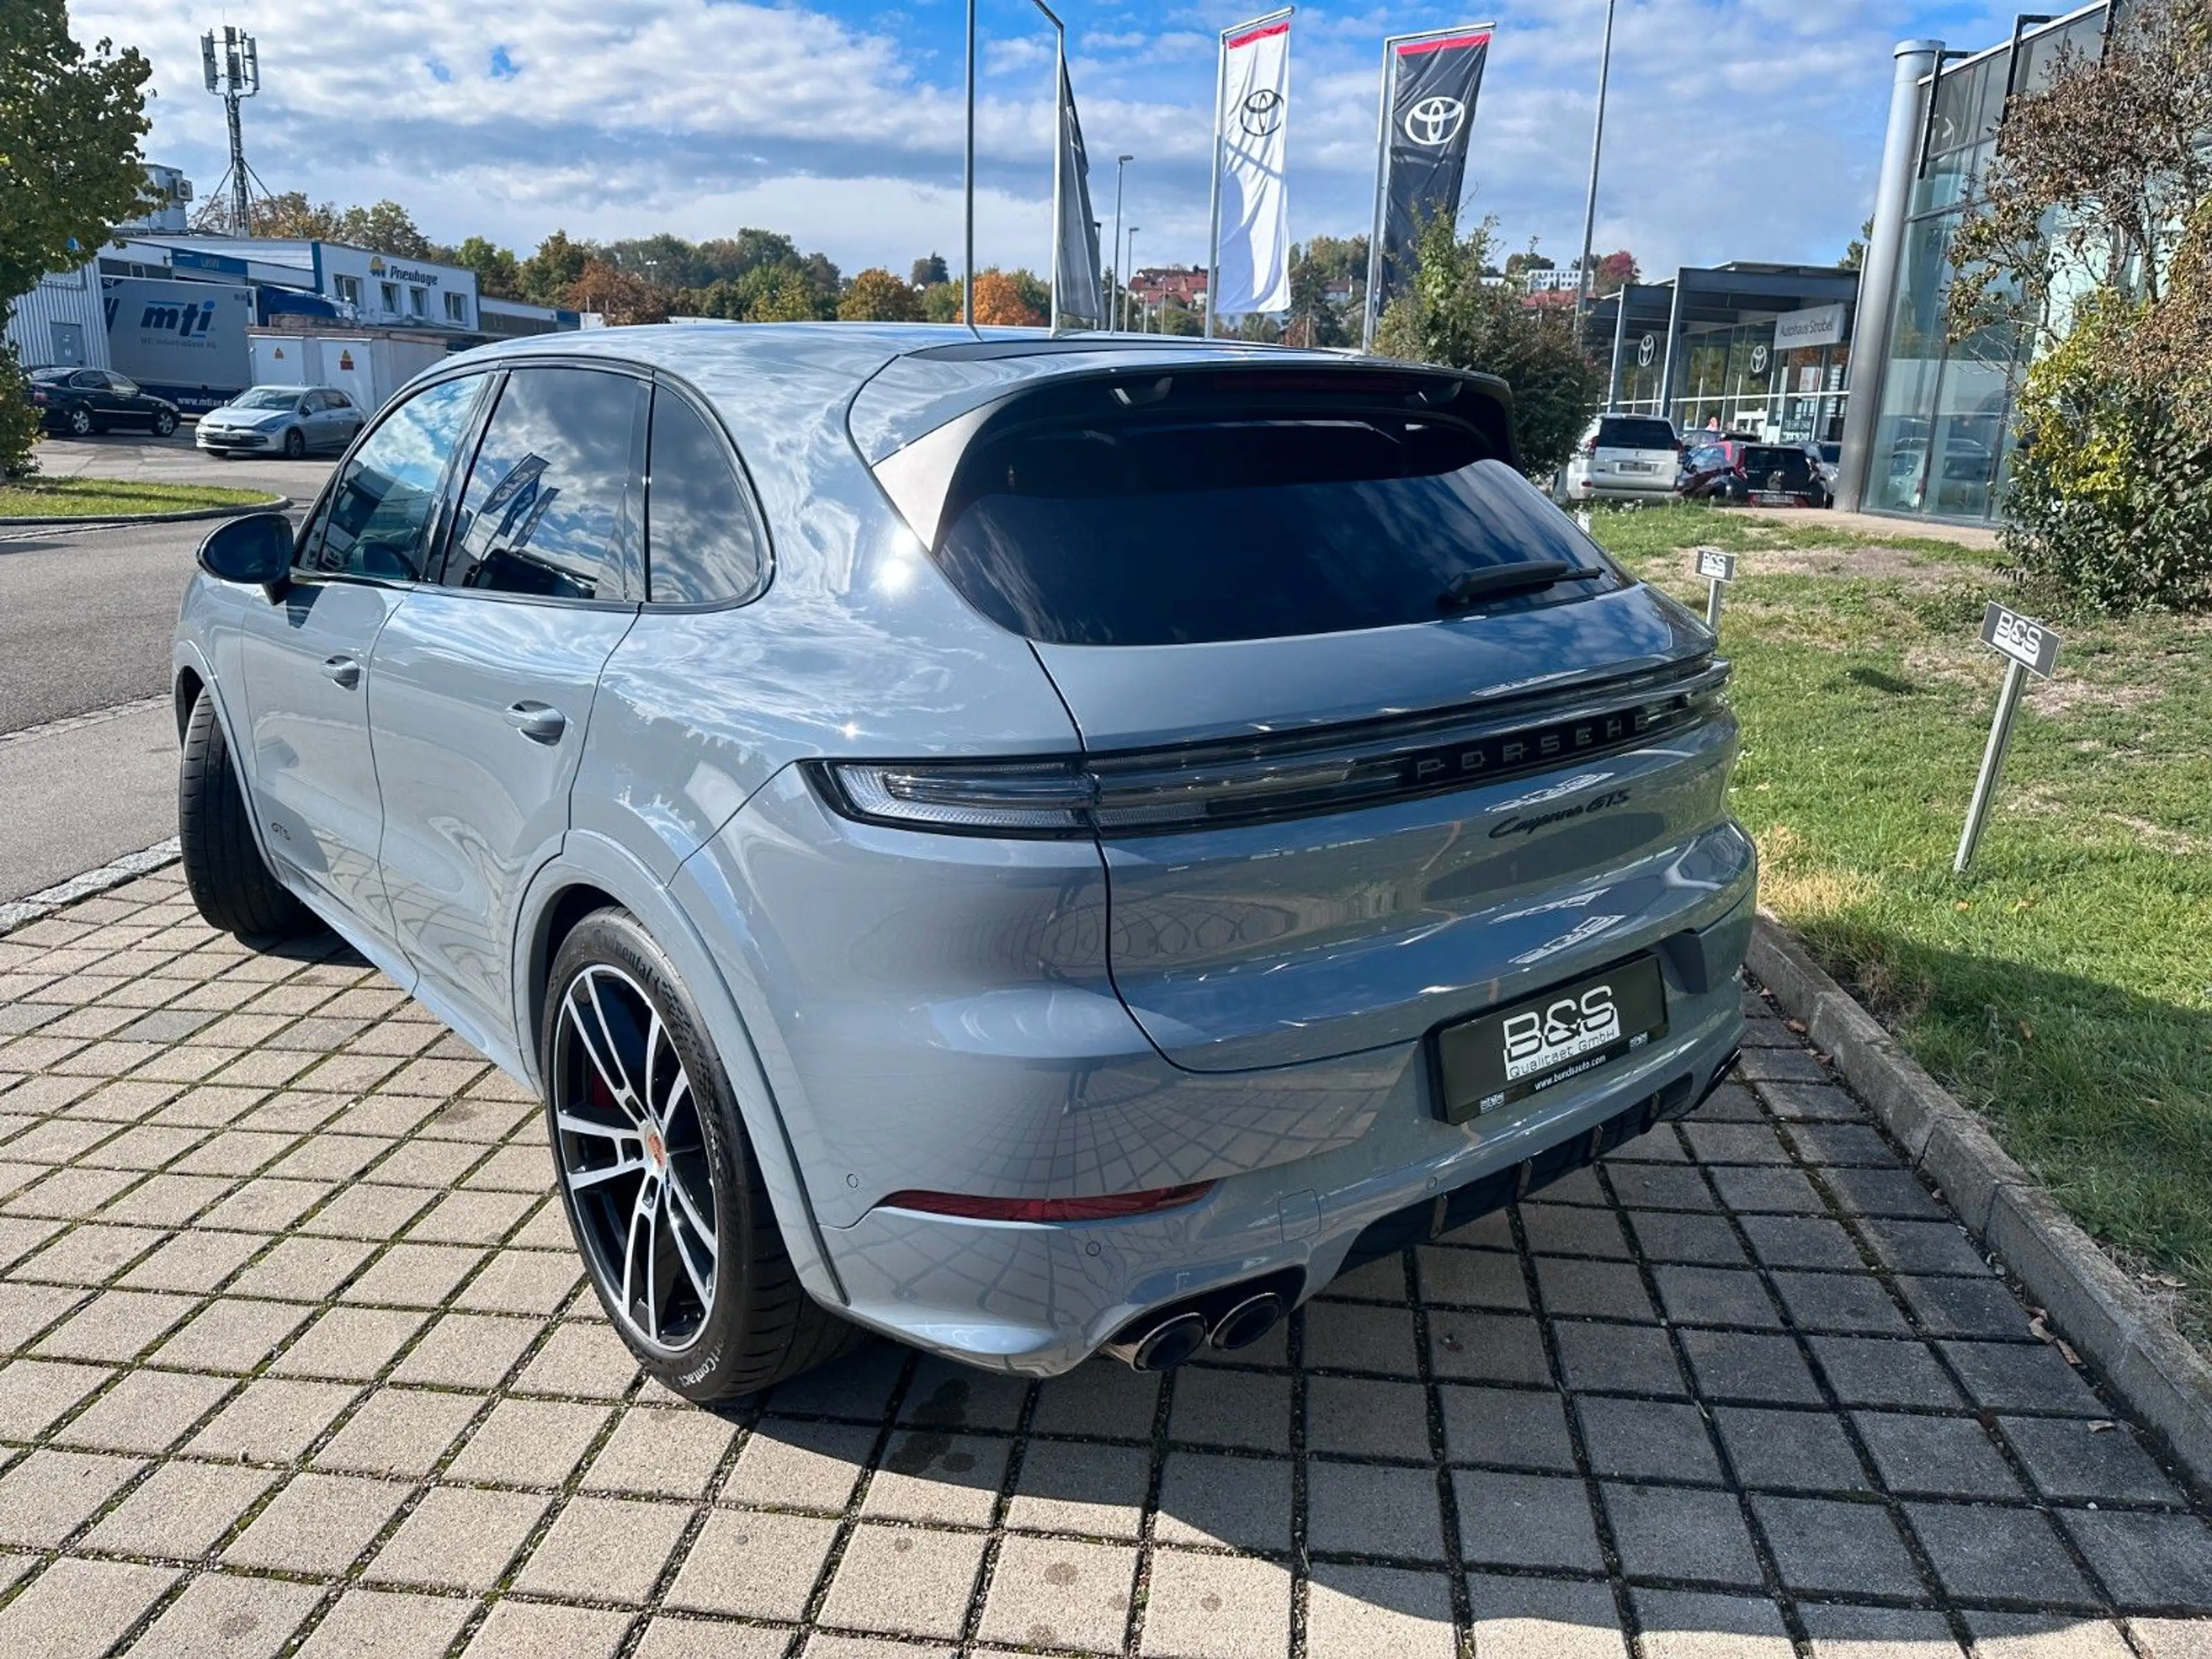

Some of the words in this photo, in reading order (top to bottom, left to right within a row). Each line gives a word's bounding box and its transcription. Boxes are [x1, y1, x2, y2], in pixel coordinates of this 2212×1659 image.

[390, 265, 438, 287] Pneuhage
[141, 301, 216, 336] mti
[1996, 611, 2043, 655] B&S
[1416, 714, 1649, 779] PORSCHE
[271, 823, 291, 840] GTS
[1488, 805, 1584, 839] Cayenne
[1586, 788, 1631, 813] GTS
[1502, 985, 1615, 1063] B&S
[1509, 1045, 1574, 1078] Qualitaet
[1578, 1028, 1615, 1052] GmbH
[1534, 1054, 1607, 1091] www.bundsauto.com
